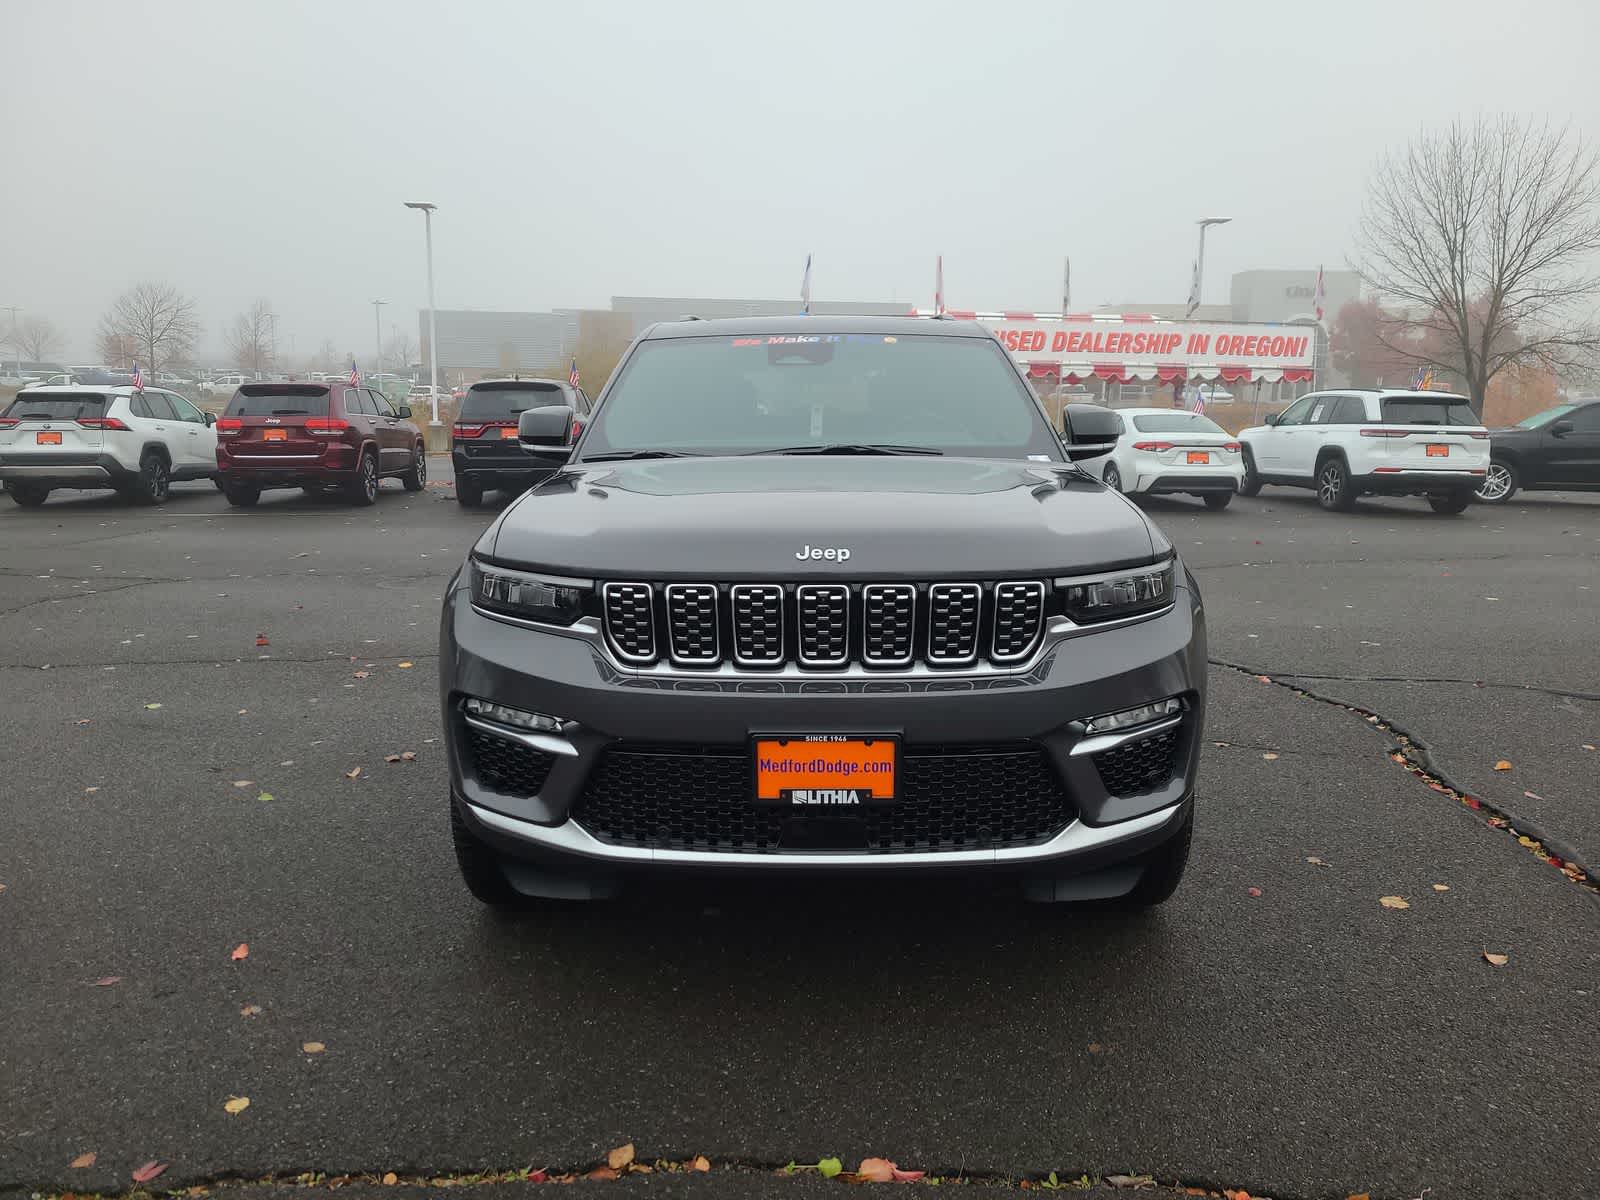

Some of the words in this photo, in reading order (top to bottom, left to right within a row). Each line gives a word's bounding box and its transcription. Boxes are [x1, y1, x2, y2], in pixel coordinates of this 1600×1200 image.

[1051, 331, 1183, 354] DEALERSHIP
[1186, 334, 1211, 354] IN
[1215, 334, 1309, 357] OREGON!
[795, 544, 851, 563] Jeep
[760, 759, 892, 776] MedfordDodge.com
[807, 790, 860, 804] LITHIA
